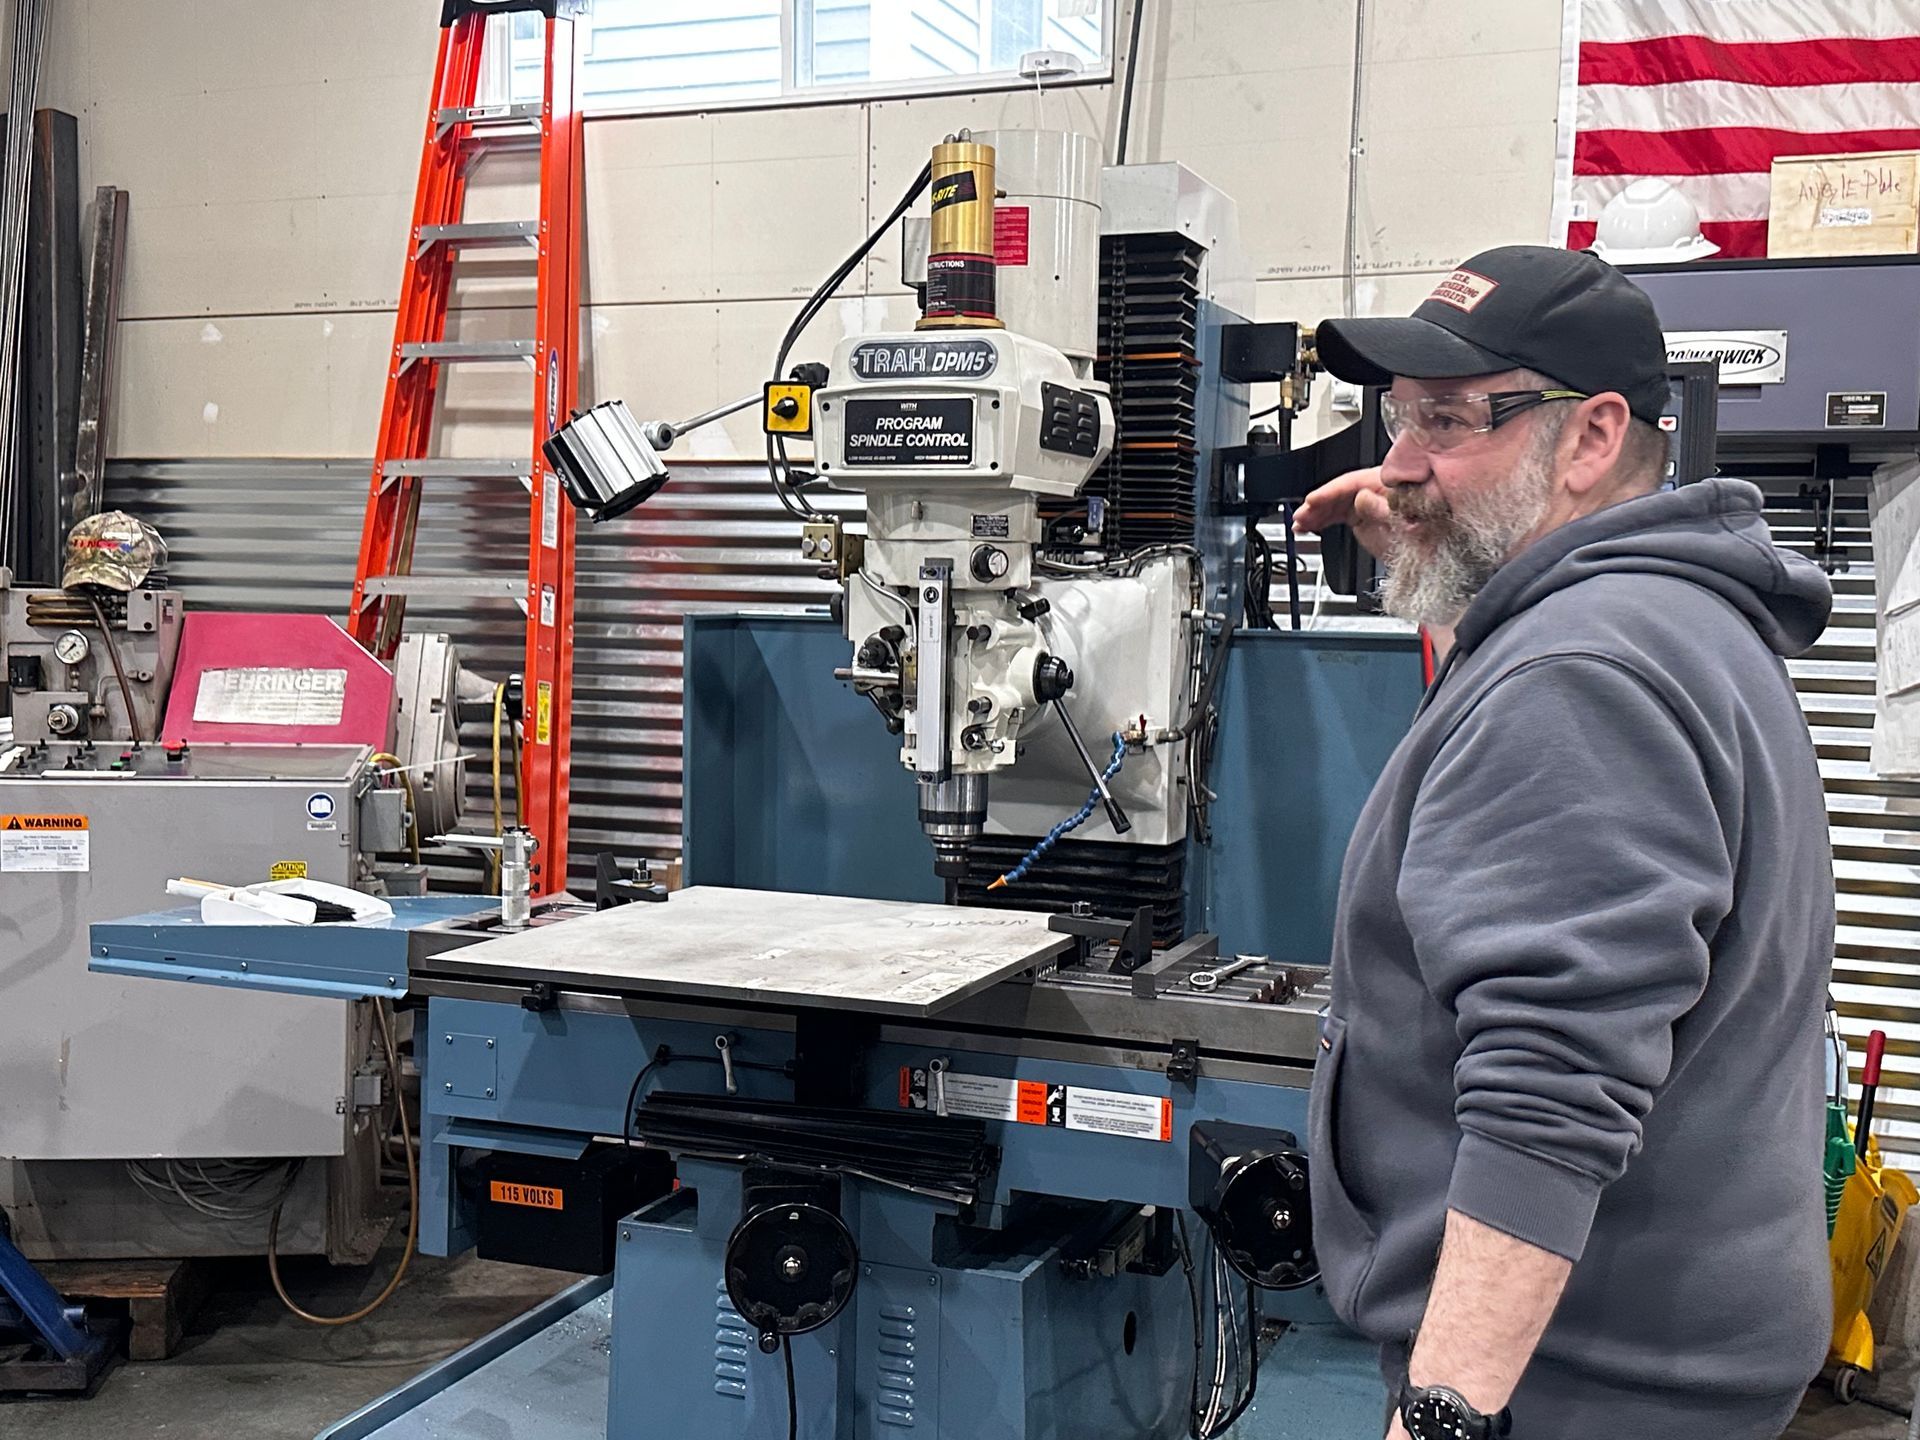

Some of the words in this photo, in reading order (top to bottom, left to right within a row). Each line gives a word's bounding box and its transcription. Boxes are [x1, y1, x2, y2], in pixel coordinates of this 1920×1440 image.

[859, 348, 927, 373] TRAK
[931, 351, 987, 372] DPM5
[875, 416, 944, 430] PROGRAM
[850, 434, 903, 447] SPINDLE
[906, 433, 969, 447] CONTROL
[223, 673, 345, 692] EHRINGER
[24, 818, 83, 828] WARNING
[501, 1185, 519, 1202] 115
[523, 1187, 554, 1206] VOLTS
